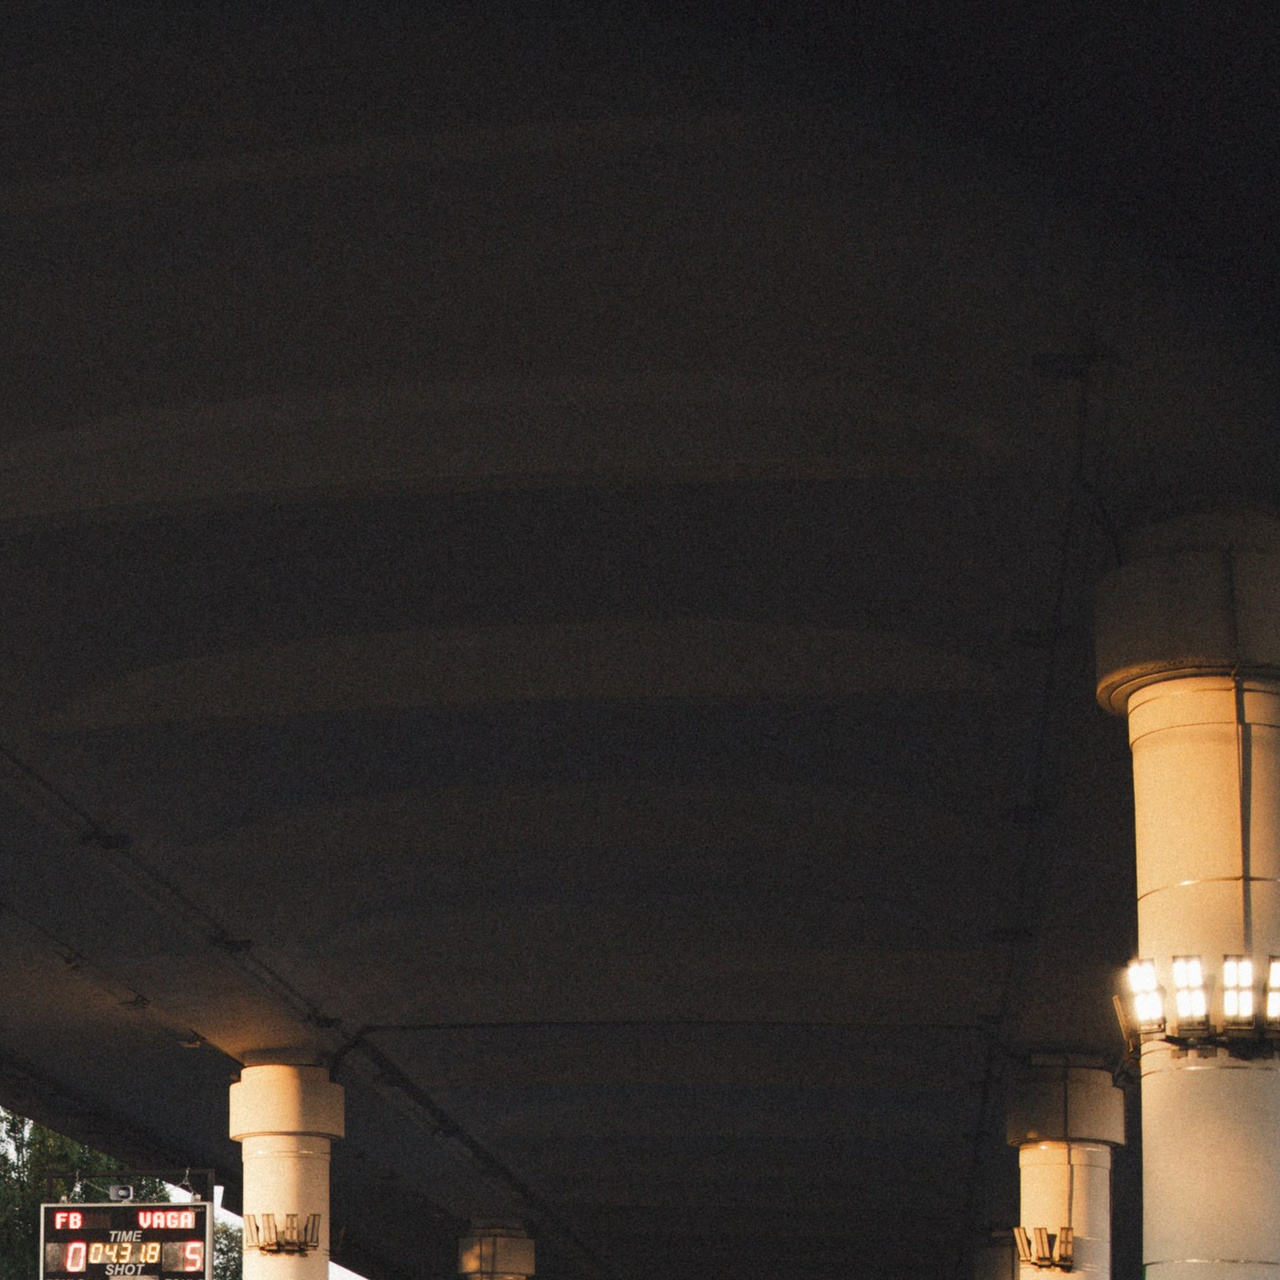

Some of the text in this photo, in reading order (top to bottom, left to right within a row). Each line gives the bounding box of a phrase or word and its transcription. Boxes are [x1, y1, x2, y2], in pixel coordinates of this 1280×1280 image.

[55, 1211, 194, 1230] FB VAGA
[109, 1231, 142, 1242] TIME
[66, 1242, 87, 1272] 0
[185, 1242, 202, 1272] 5
[105, 1264, 145, 1276] SHOT
